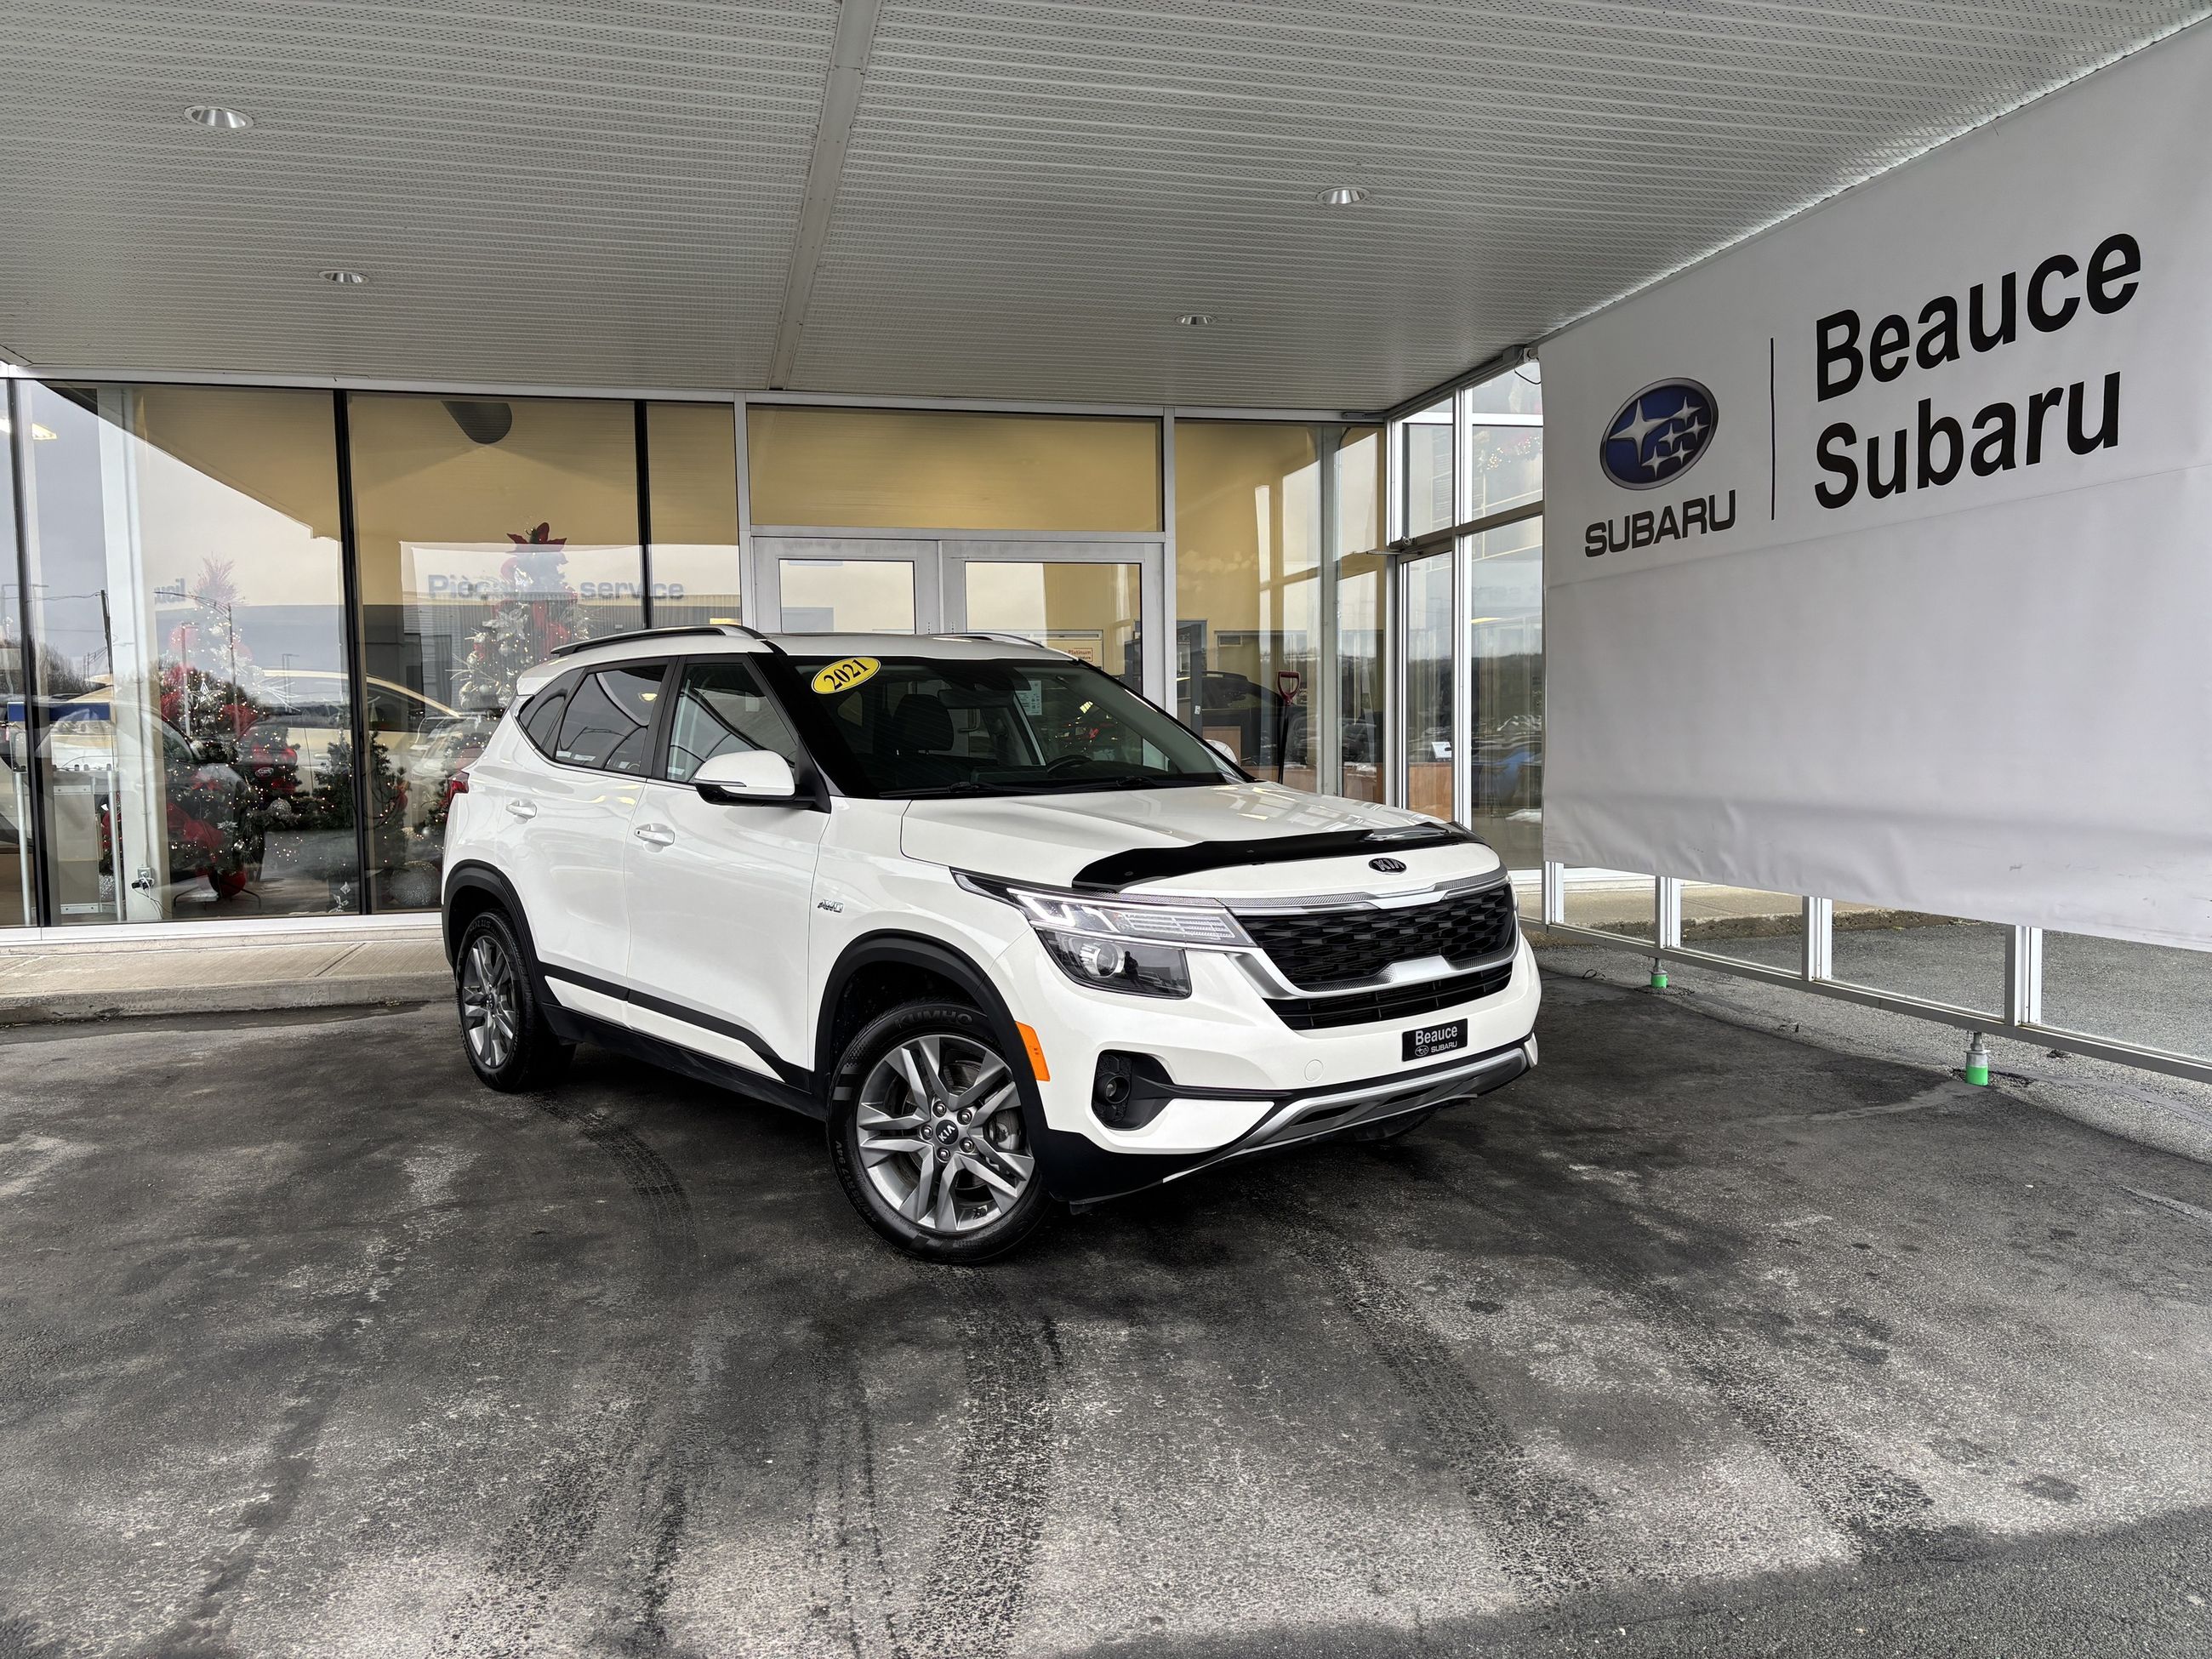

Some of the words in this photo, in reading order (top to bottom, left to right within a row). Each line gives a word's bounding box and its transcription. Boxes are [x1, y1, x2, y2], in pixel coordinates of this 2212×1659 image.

[1816, 233, 2141, 402] Beauce
[1814, 371, 2121, 510] Subaru
[1585, 489, 1736, 558] SUBARU
[580, 581, 685, 600] servce
[824, 658, 870, 691] 2021
[1372, 859, 1405, 871] KIA
[817, 899, 844, 913] AWD
[895, 1009, 972, 1028] KUMHO
[1415, 1025, 1458, 1046] Beauce
[1430, 1040, 1458, 1053] SUBARU
[938, 1125, 955, 1142] KIA
